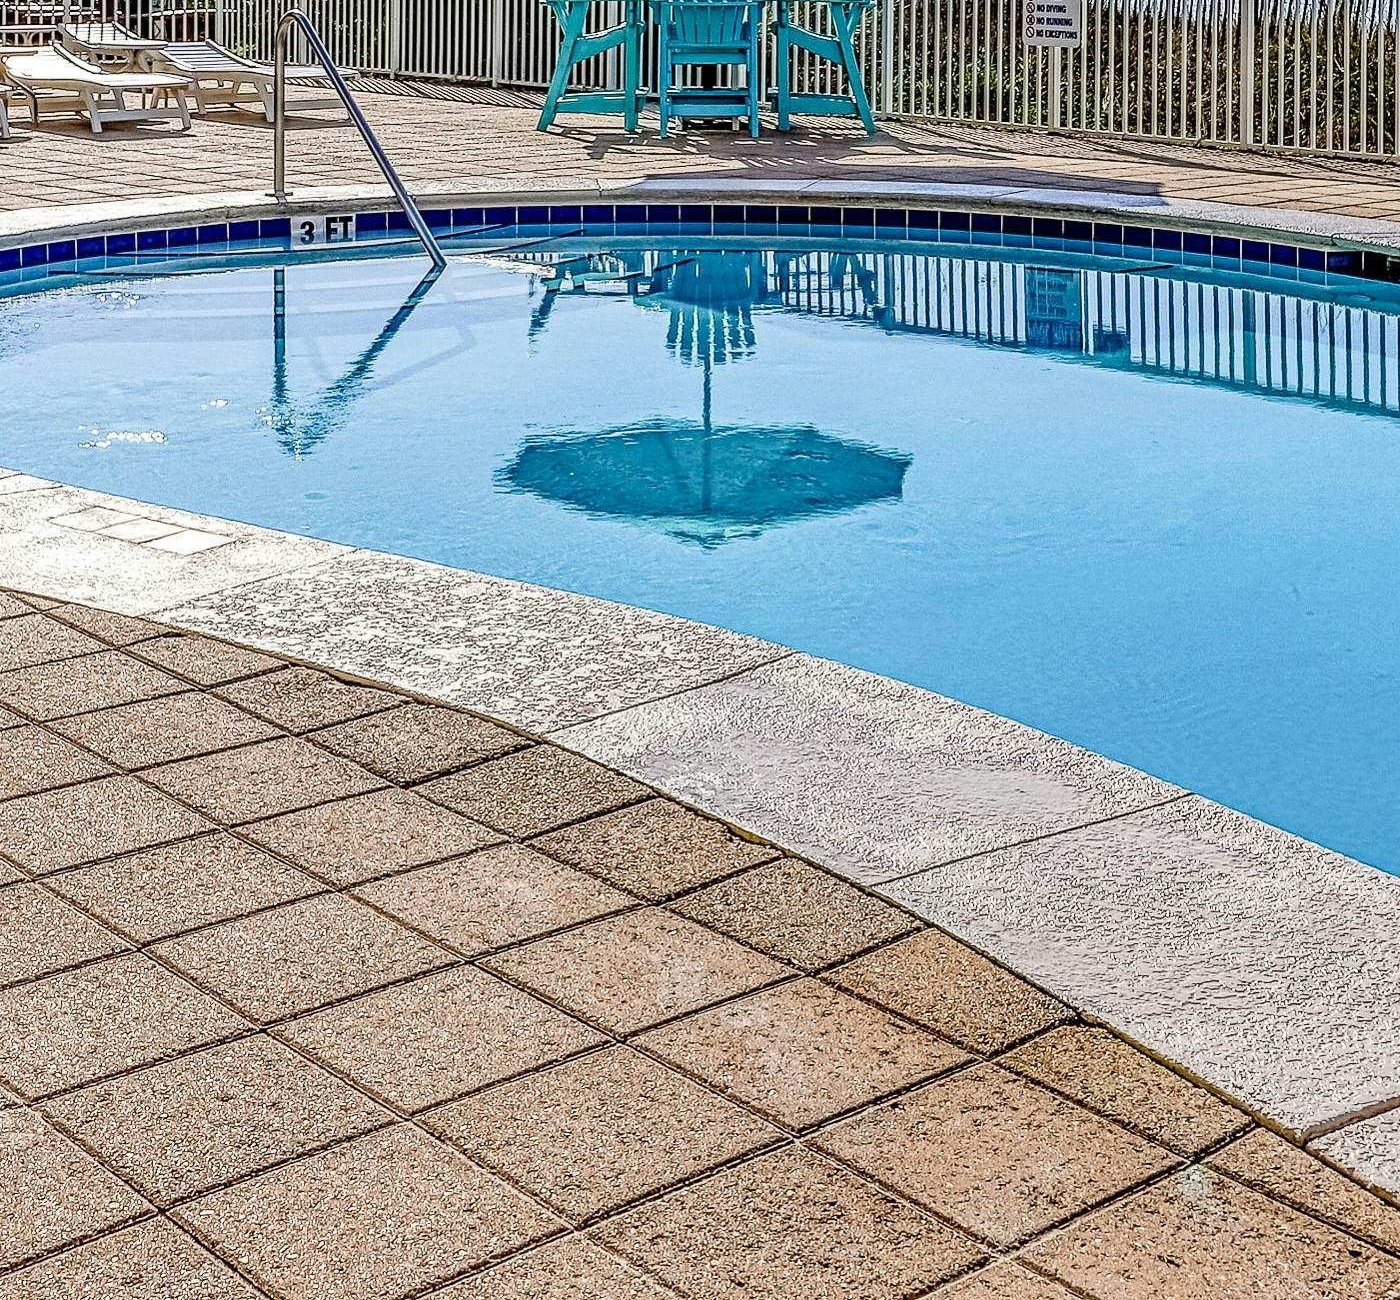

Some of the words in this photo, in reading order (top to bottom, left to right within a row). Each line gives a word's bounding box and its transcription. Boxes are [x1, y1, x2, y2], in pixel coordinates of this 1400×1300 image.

[1036, 4, 1045, 12] NO
[1046, 5, 1067, 14] DIVING
[1036, 17, 1045, 25] NO
[1046, 17, 1073, 27] RUNNING
[1045, 30, 1078, 40] EXCEPTIONS
[300, 220, 315, 245] 3
[326, 216, 353, 243] FT
